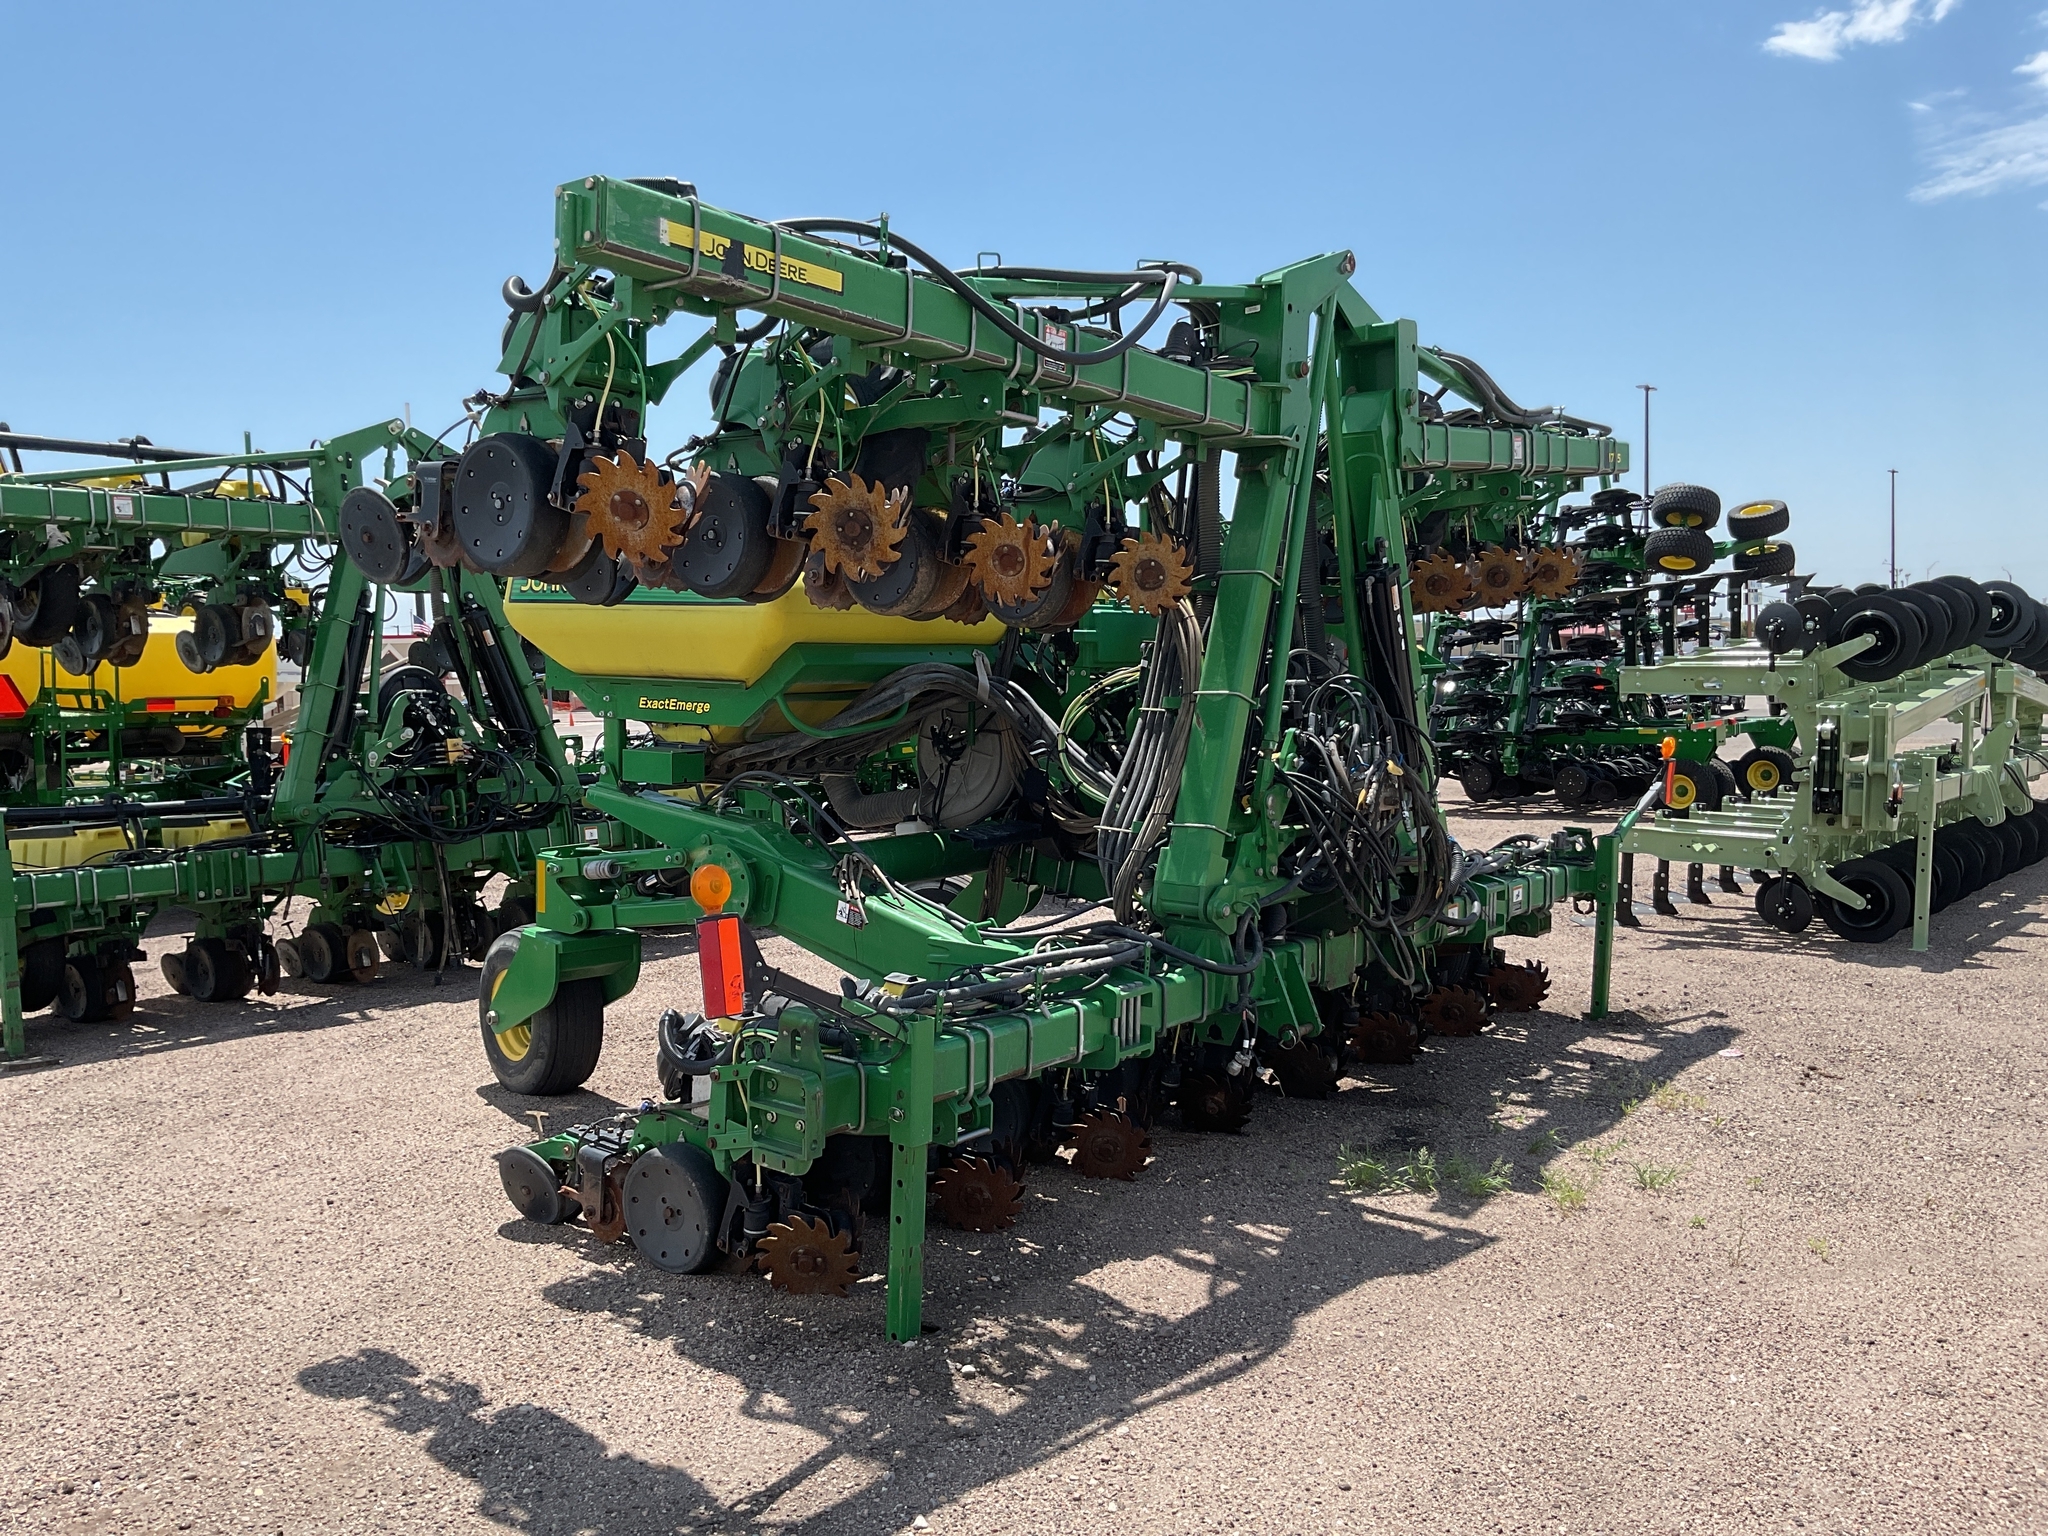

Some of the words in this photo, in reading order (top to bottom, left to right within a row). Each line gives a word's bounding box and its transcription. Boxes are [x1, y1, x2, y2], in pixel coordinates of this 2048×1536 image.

[705, 237, 751, 266] JON
[755, 250, 807, 282] DEERE
[1609, 452, 1622, 463] 175
[638, 696, 711, 714] ExactEmerge
